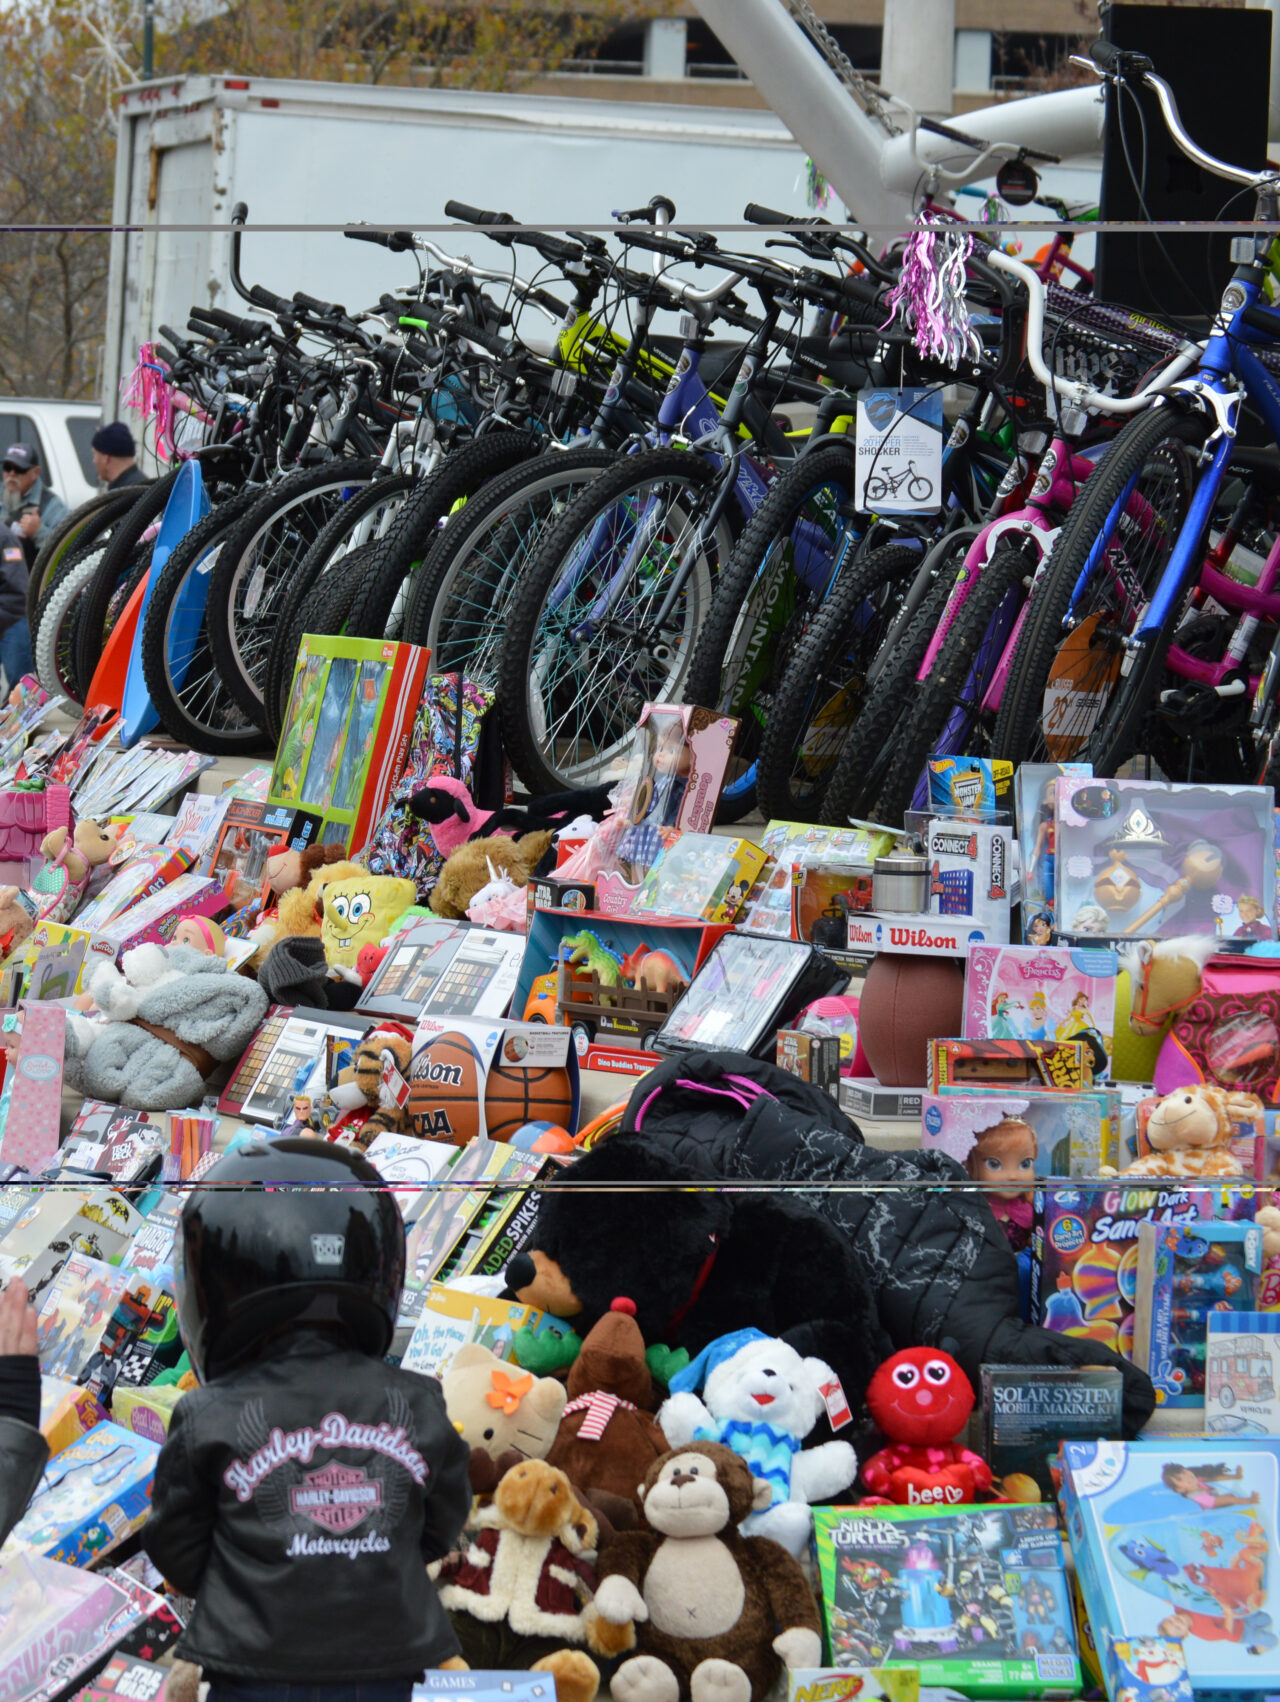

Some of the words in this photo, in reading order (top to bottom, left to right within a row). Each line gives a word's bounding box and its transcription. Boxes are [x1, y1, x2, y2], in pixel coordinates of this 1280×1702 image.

[876, 438, 901, 447] HYPER
[858, 447, 901, 456] SHOCKER
[399, 733, 408, 750] Set
[395, 747, 405, 767] Play
[954, 782, 982, 797] MONSTER
[688, 773, 712, 828] Country
[932, 835, 968, 855] CONNECT
[967, 832, 978, 861] 4
[991, 834, 1002, 887] CONNECT
[148, 877, 167, 895] Art
[535, 886, 551, 896] STAR
[988, 885, 1006, 900] 4
[603, 893, 628, 907] Country
[849, 923, 873, 945] Wilson
[889, 927, 958, 950] Wilson
[420, 1020, 445, 1032] Wilson
[597, 1058, 611, 1067] Dino
[611, 1060, 634, 1070] Buddies
[903, 1097, 921, 1106] RED
[111, 1141, 132, 1154] TECH
[111, 1149, 132, 1160] DECK
[1158, 1190, 1189, 1208] Dark
[1062, 1219, 1072, 1231] 6
[433, 1325, 446, 1339] the
[430, 1342, 446, 1358] Go!
[420, 1359, 436, 1370] Game
[993, 1387, 1050, 1403] SOLAR
[1053, 1387, 1119, 1404] SYSTEM
[994, 1403, 1041, 1414] MOBILE
[1043, 1403, 1095, 1415] MAKING
[1097, 1404, 1118, 1415] KIT
[224, 1412, 428, 1501] Harley-Davidson
[295, 1486, 378, 1507] HARLEY-DAVIDSON
[907, 1484, 944, 1507] bee
[838, 1520, 898, 1533] NINJA
[285, 1530, 391, 1560] Motorcycles
[828, 1526, 911, 1549] TURTLES
[1039, 1659, 1071, 1668] MEGA
[123, 1664, 163, 1684] STAR
[113, 1679, 159, 1700] WARS
[429, 1676, 477, 1689] GAMES
[794, 1676, 863, 1702] NERF
